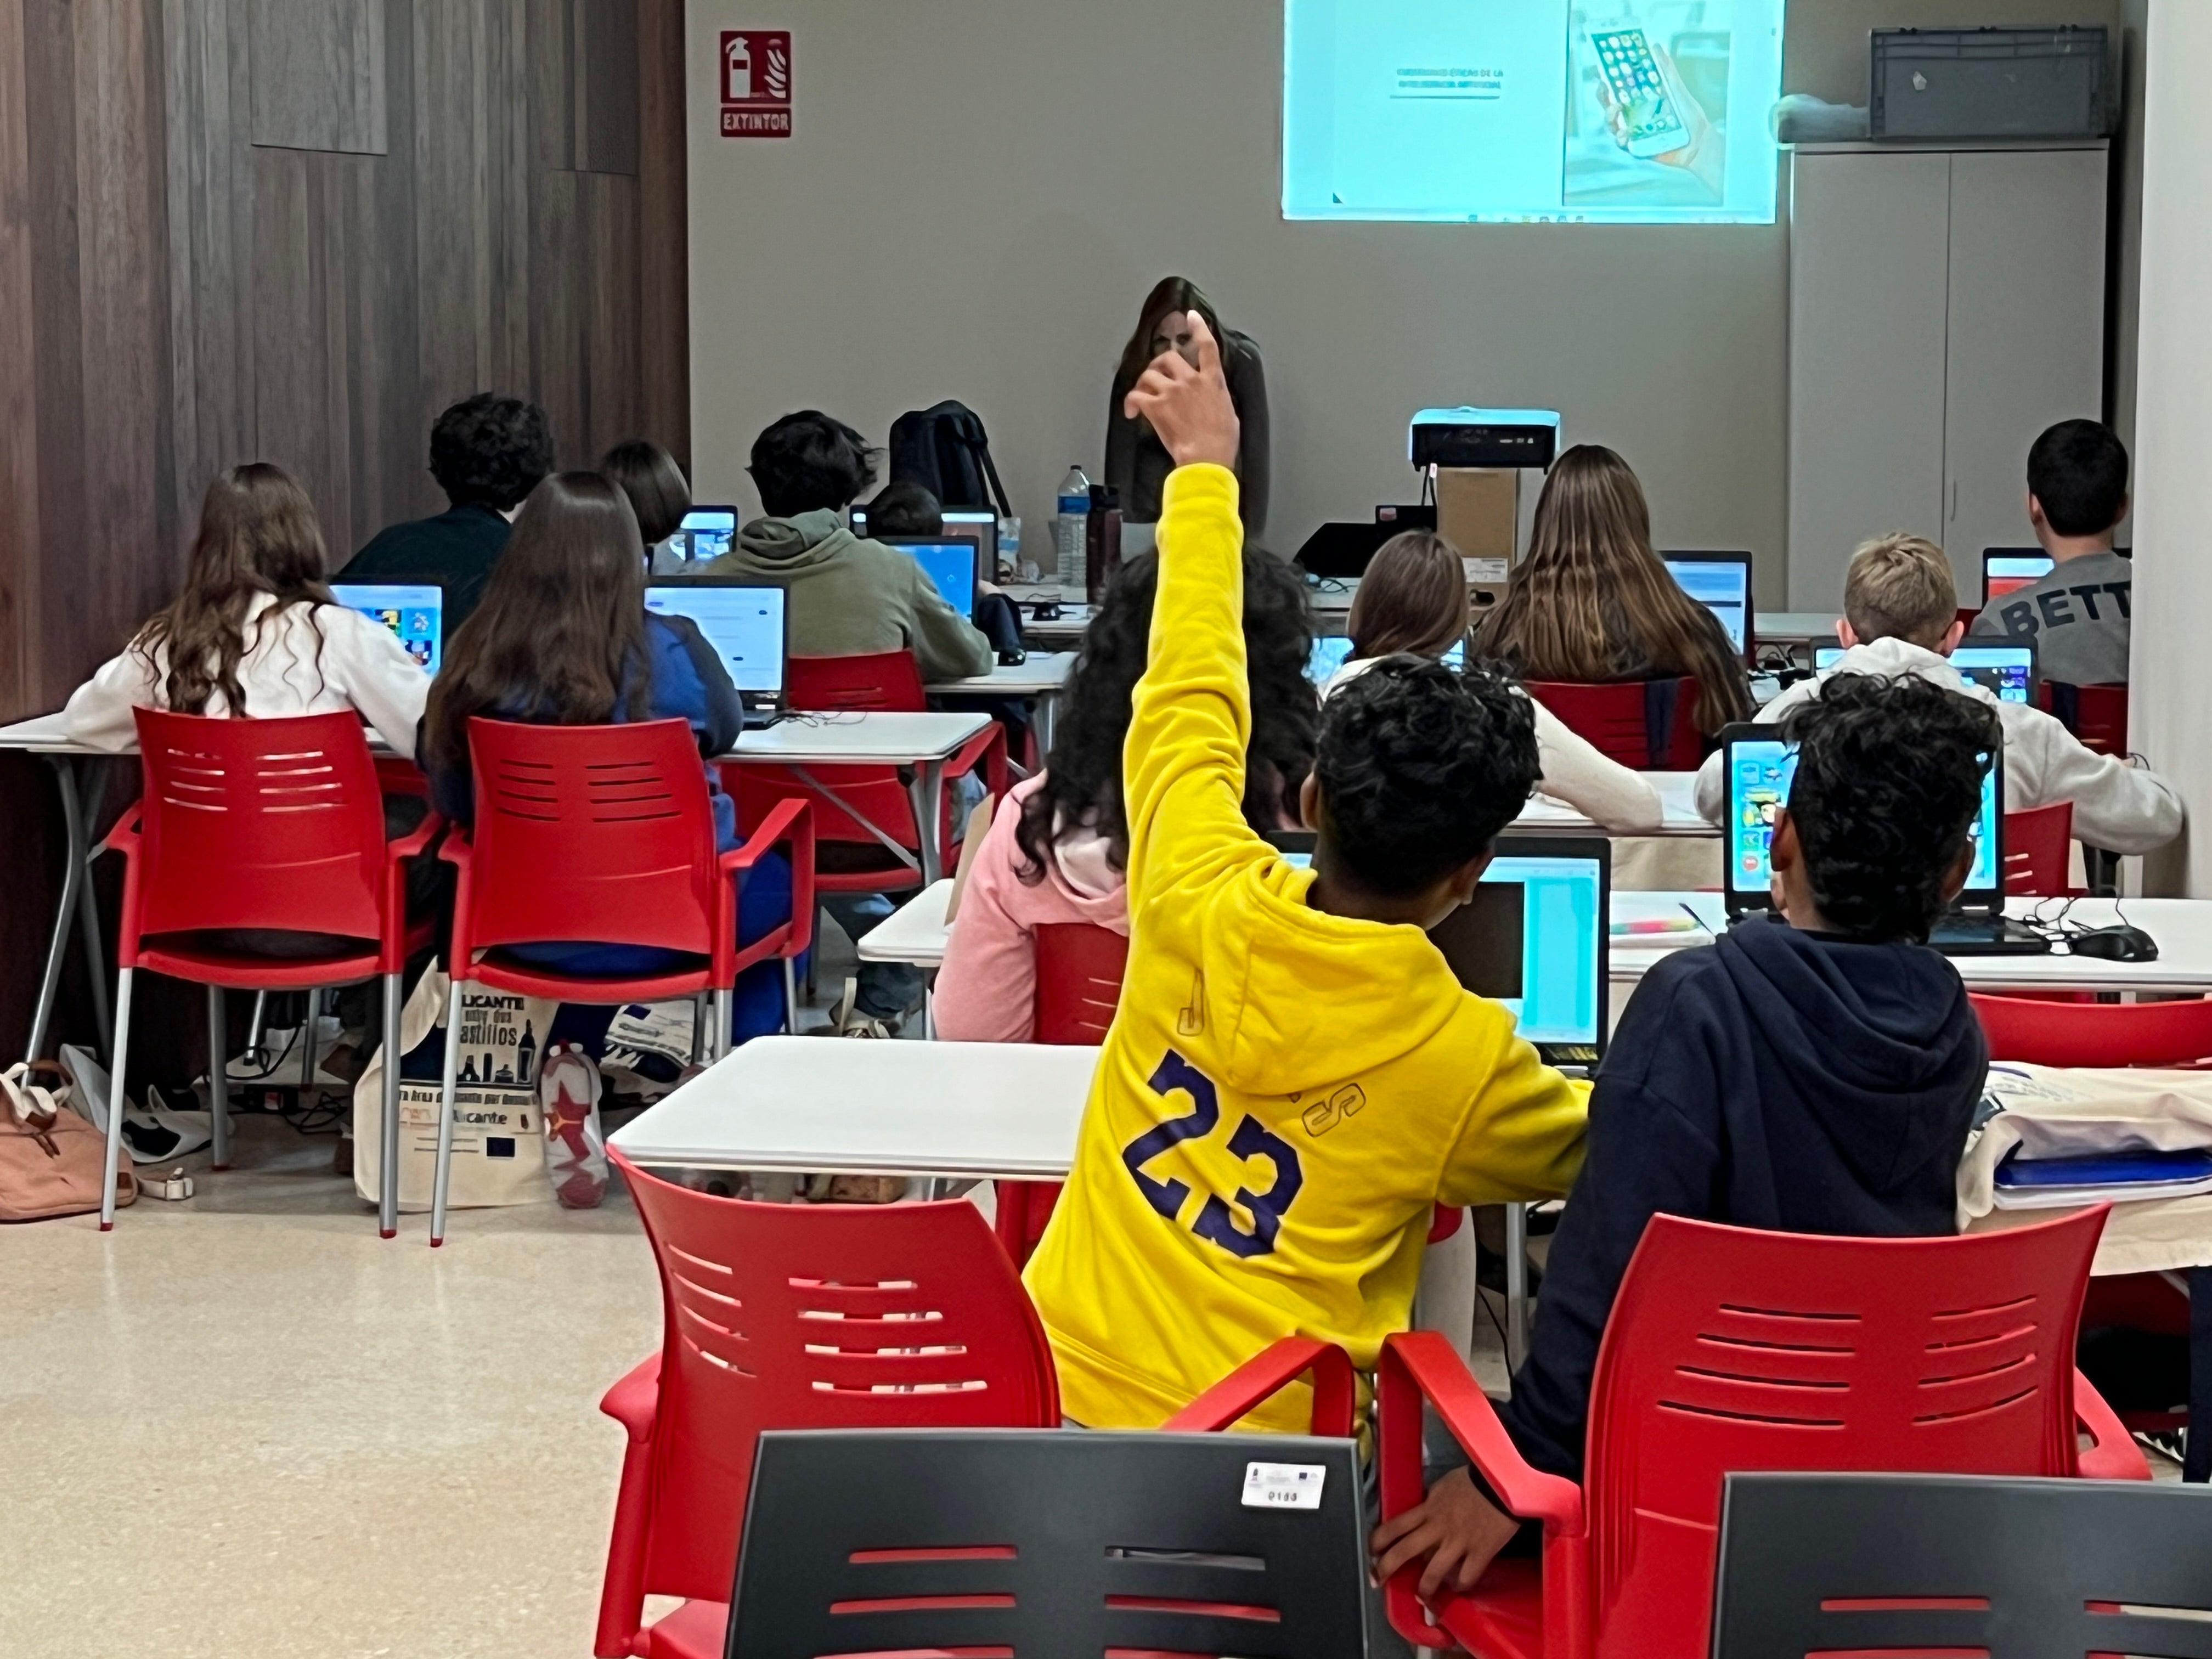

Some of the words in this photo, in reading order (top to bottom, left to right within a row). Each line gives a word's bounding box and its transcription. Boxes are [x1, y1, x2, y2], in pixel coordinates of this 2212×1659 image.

[724, 113, 789, 130] EXTINTOR
[462, 994, 524, 1011] LICANTE
[460, 1024, 517, 1046] astillos
[1122, 1048, 1304, 1258] 23
